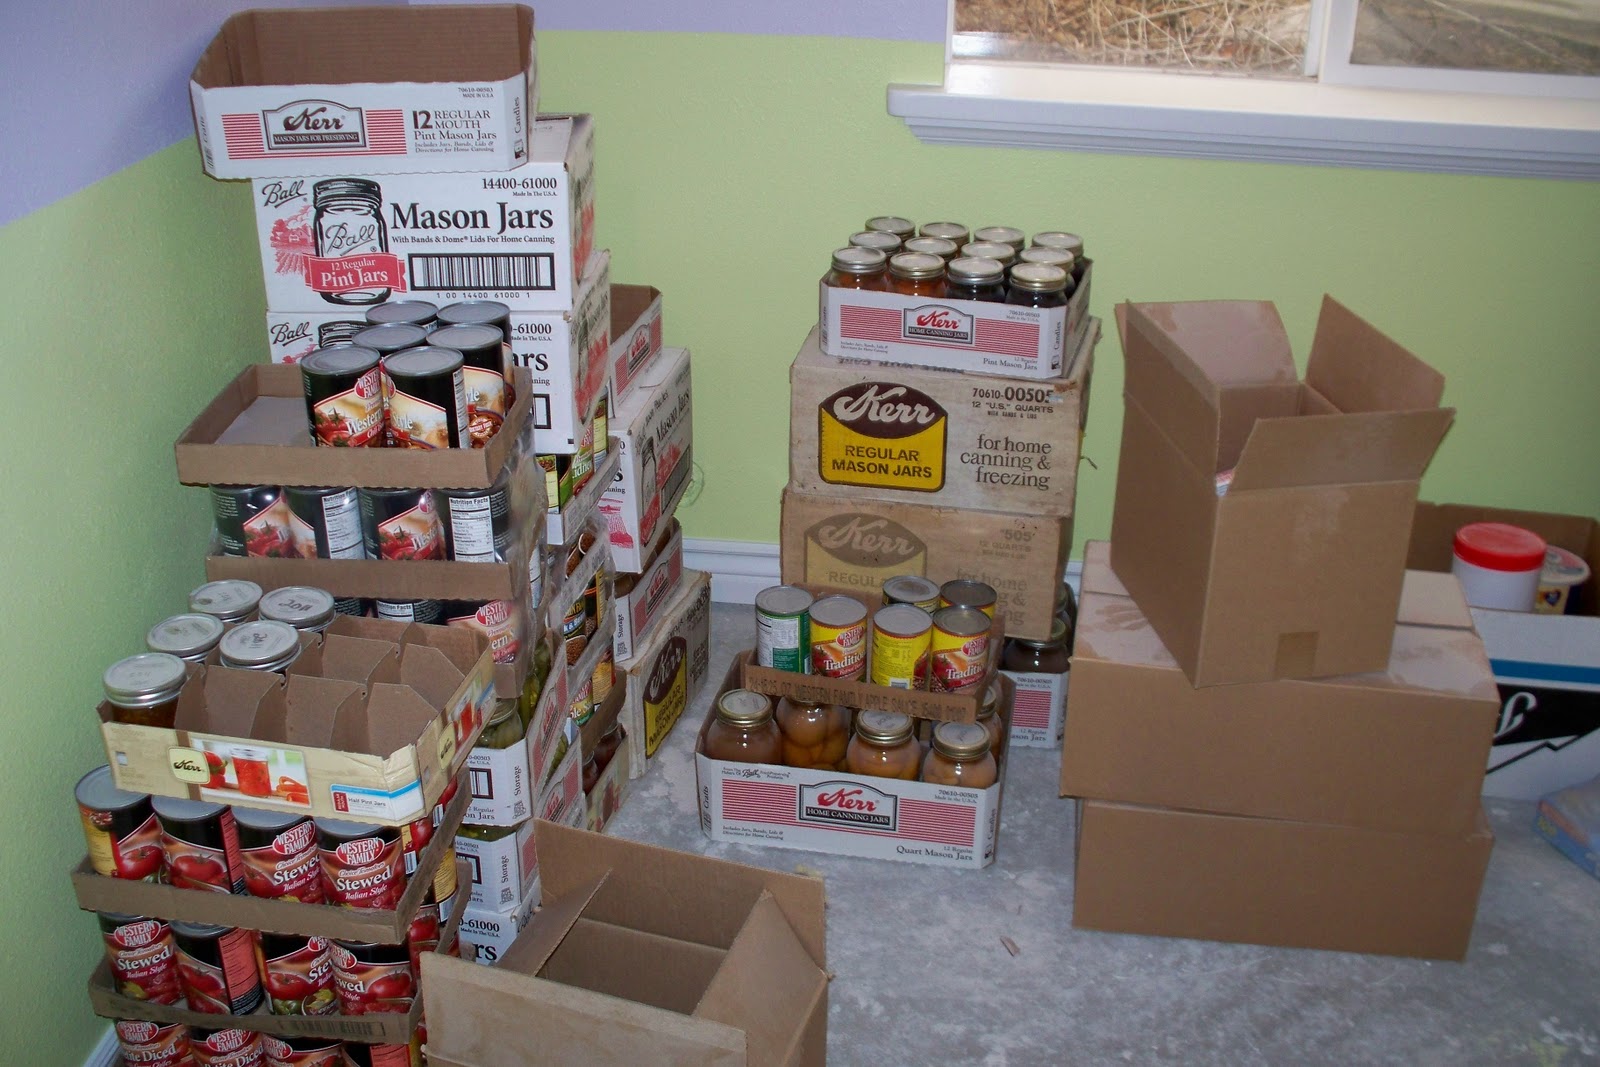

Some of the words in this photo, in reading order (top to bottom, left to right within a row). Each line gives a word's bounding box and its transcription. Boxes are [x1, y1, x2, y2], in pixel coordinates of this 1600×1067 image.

[283, 106, 346, 131] Kerr
[412, 110, 433, 130] 12
[434, 110, 491, 120] REGULAR
[514, 96, 522, 134] Candles
[435, 120, 481, 129] MOUTH
[273, 135, 295, 143] MASON
[296, 135, 309, 143] JARS
[309, 134, 321, 142] FOR
[321, 133, 358, 142] PRESERVING
[413, 130, 436, 140] Pint
[439, 130, 474, 140] Mason
[477, 130, 497, 141] Jars
[482, 177, 558, 189] 14400-61000
[262, 180, 308, 208] Ball
[390, 202, 491, 230] Mason
[496, 201, 554, 235] Jars
[325, 222, 376, 257] Ball
[391, 235, 410, 243] With
[411, 235, 434, 243] Bands
[470, 235, 486, 243] Lids
[486, 235, 500, 243] For
[500, 235, 523, 243] Home
[523, 234, 556, 244] Canning
[330, 262, 341, 272] 12
[342, 257, 376, 270] Regular
[321, 272, 355, 288] Pint
[357, 268, 389, 286] Jars
[916, 309, 959, 330] Kerr
[270, 321, 314, 348] Ball
[909, 327, 926, 335] HOME
[925, 328, 953, 337] CANNING
[1054, 321, 1062, 351] Candles
[982, 357, 998, 366] Pint
[999, 359, 1023, 369] Mason
[1023, 362, 1038, 371] Jars
[833, 384, 936, 425] Kerr
[1014, 404, 1054, 414] QUARTS
[844, 444, 920, 461] REGULAR
[976, 433, 1001, 451] for
[1003, 435, 1052, 455] home
[831, 458, 889, 475] MASON
[892, 463, 933, 478] JARS
[960, 451, 1034, 473] canning
[1036, 454, 1052, 470] &
[975, 465, 1051, 491] freezing
[474, 497, 489, 505] Facts
[817, 516, 915, 556] Kerr
[982, 572, 1029, 592] home
[617, 612, 625, 638] Storage
[1030, 734, 1047, 742] Jars
[173, 759, 203, 773] Kerr
[742, 768, 761, 779] Ball
[514, 765, 522, 797] Storage
[817, 788, 878, 812] Kerr
[938, 789, 979, 798] 70610-00505
[478, 813, 497, 821] Jars
[807, 808, 830, 817] HOME
[830, 809, 869, 822] CANNING
[869, 815, 889, 824] JARS
[275, 820, 314, 847] WESTERN
[284, 834, 313, 855] FAMILY
[338, 836, 380, 855] WESTERN
[896, 845, 922, 856] Quart
[924, 849, 953, 860] Mason
[955, 852, 974, 861] Jars
[952, 846, 974, 855] Regular
[346, 850, 376, 866] FAMILY
[338, 868, 359, 877] Choice
[357, 860, 386, 876] Tomatoes
[501, 855, 510, 884] Storage
[282, 878, 307, 893] Italian
[335, 865, 394, 893] Stewed
[344, 890, 368, 901] Italian
[369, 882, 389, 897] Style
[117, 919, 155, 937] WESTERN
[461, 926, 473, 934] Made
[123, 930, 153, 948] FAMILY
[116, 945, 172, 972] Stewed
[125, 969, 149, 979] Italian
[149, 962, 169, 976] Style
[344, 991, 362, 1002] Style
[125, 1031, 150, 1044] FAMILY
[217, 1036, 244, 1053] FAMILY
[142, 1043, 177, 1062] Diced
[235, 1042, 265, 1067] Diced
